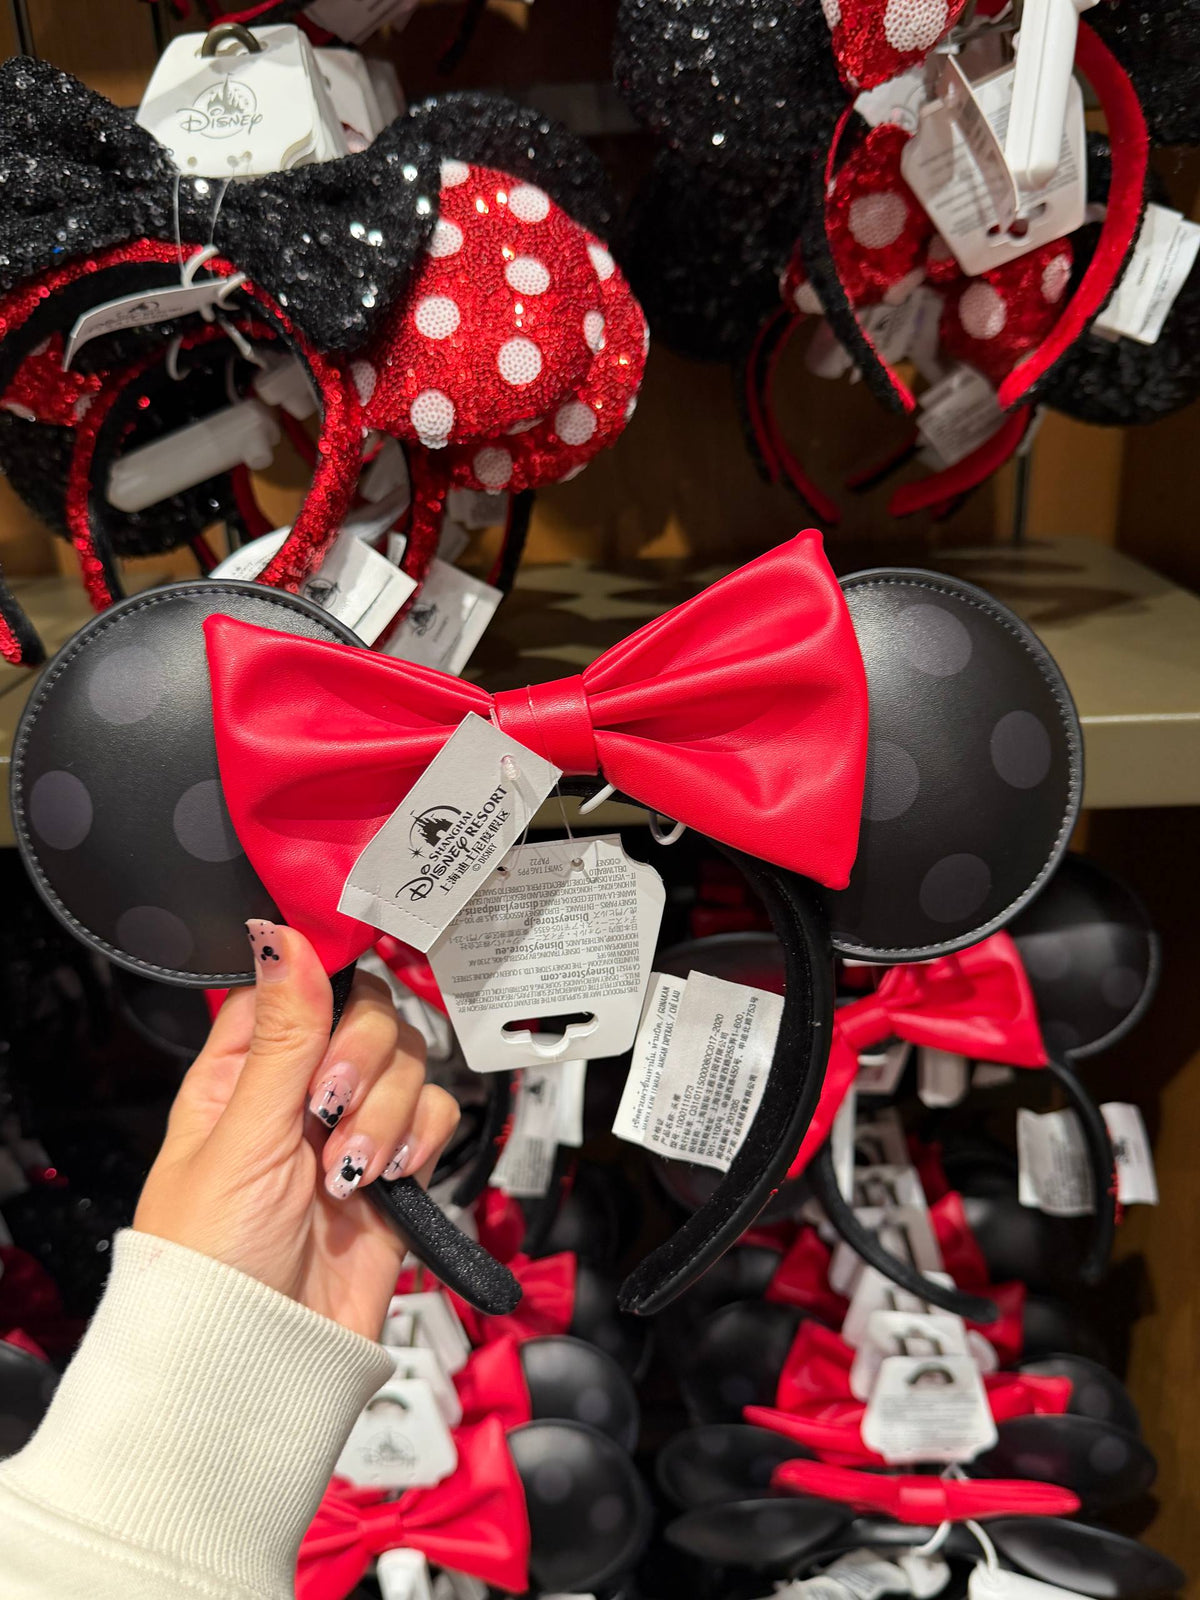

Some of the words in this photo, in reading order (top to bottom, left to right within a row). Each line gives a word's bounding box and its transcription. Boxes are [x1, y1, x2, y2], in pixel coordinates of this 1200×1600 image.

[461, 784, 507, 837] RESORT
[439, 807, 510, 895] 上海迪士尼度假区
[477, 842, 497, 864] DISNEY
[529, 856, 549, 866] PAP22
[529, 866, 543, 875] TAG
[543, 863, 563, 873] SWIFT
[607, 873, 625, 882] VISITA
[630, 871, 636, 879] IT
[530, 882, 541, 891] PER
[597, 882, 613, 891] KONG
[613, 880, 629, 889] HONG
[497, 884, 525, 895] CORRETTO
[526, 888, 560, 899] DISNEYLAND
[559, 887, 576, 895] KONG
[575, 885, 592, 894] HONG
[483, 894, 507, 904] LANTAU
[538, 897, 560, 907] FRANCE
[569, 894, 586, 903] CEDEX
[618, 897, 637, 906] DISNEY
[565, 903, 586, 913] FRANCE
[586, 902, 594, 910] EN
[599, 900, 617, 909] PARKS
[524, 908, 544, 918] DISNEY
[544, 906, 559, 915] EURO
[464, 916, 474, 924] 100
[475, 915, 483, 923] BP
[523, 911, 589, 929] Disneystore.jp
[608, 923, 637, 933] 日本国内
[494, 938, 563, 956] DisneyStore.eu
[585, 944, 603, 952] UNION
[603, 941, 632, 950] EUROPEAN
[536, 949, 560, 958] TRADING
[561, 947, 580, 956] DISNEY
[596, 951, 606, 959] 9PE
[606, 950, 616, 958] W6
[616, 947, 639, 956] LONDON
[587, 958, 613, 967] KINGDOM
[613, 955, 633, 964] UNITED
[534, 964, 551, 973] STORE
[551, 963, 571, 971] DISNEY
[616, 964, 632, 972] 91521
[472, 970, 499, 980] CAROLINE
[499, 968, 518, 977] QUEEN
[540, 966, 615, 981] DisneyStore.com
[561, 976, 599, 987] MERCHANDISE
[600, 973, 619, 982] DISNEY
[534, 980, 561, 990] SOURCING
[599, 981, 612, 989] PEUT
[612, 979, 634, 987] PRODUIT
[602, 987, 626, 996] PRODUCT
[670, 989, 680, 1002] LAU
[556, 992, 581, 1001] SUPPLIED
[657, 985, 670, 1013] GUNAKAN
[513, 997, 539, 1006] RELEVANT
[651, 1118, 664, 1141] 合格证
